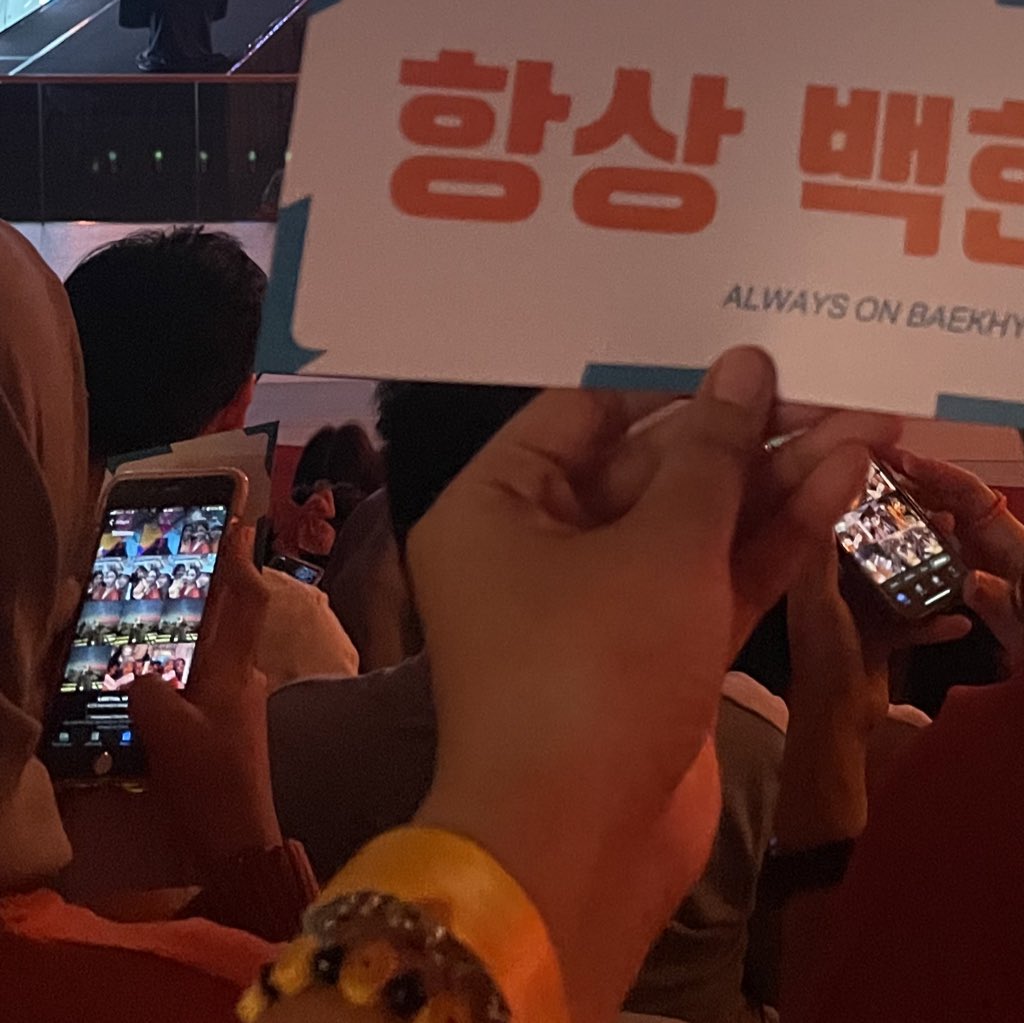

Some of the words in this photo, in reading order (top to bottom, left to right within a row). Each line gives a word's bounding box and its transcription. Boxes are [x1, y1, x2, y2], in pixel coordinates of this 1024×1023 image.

[391, 49, 746, 234] 항상
[723, 284, 850, 320] ALWAYS
[855, 296, 902, 325] ON
